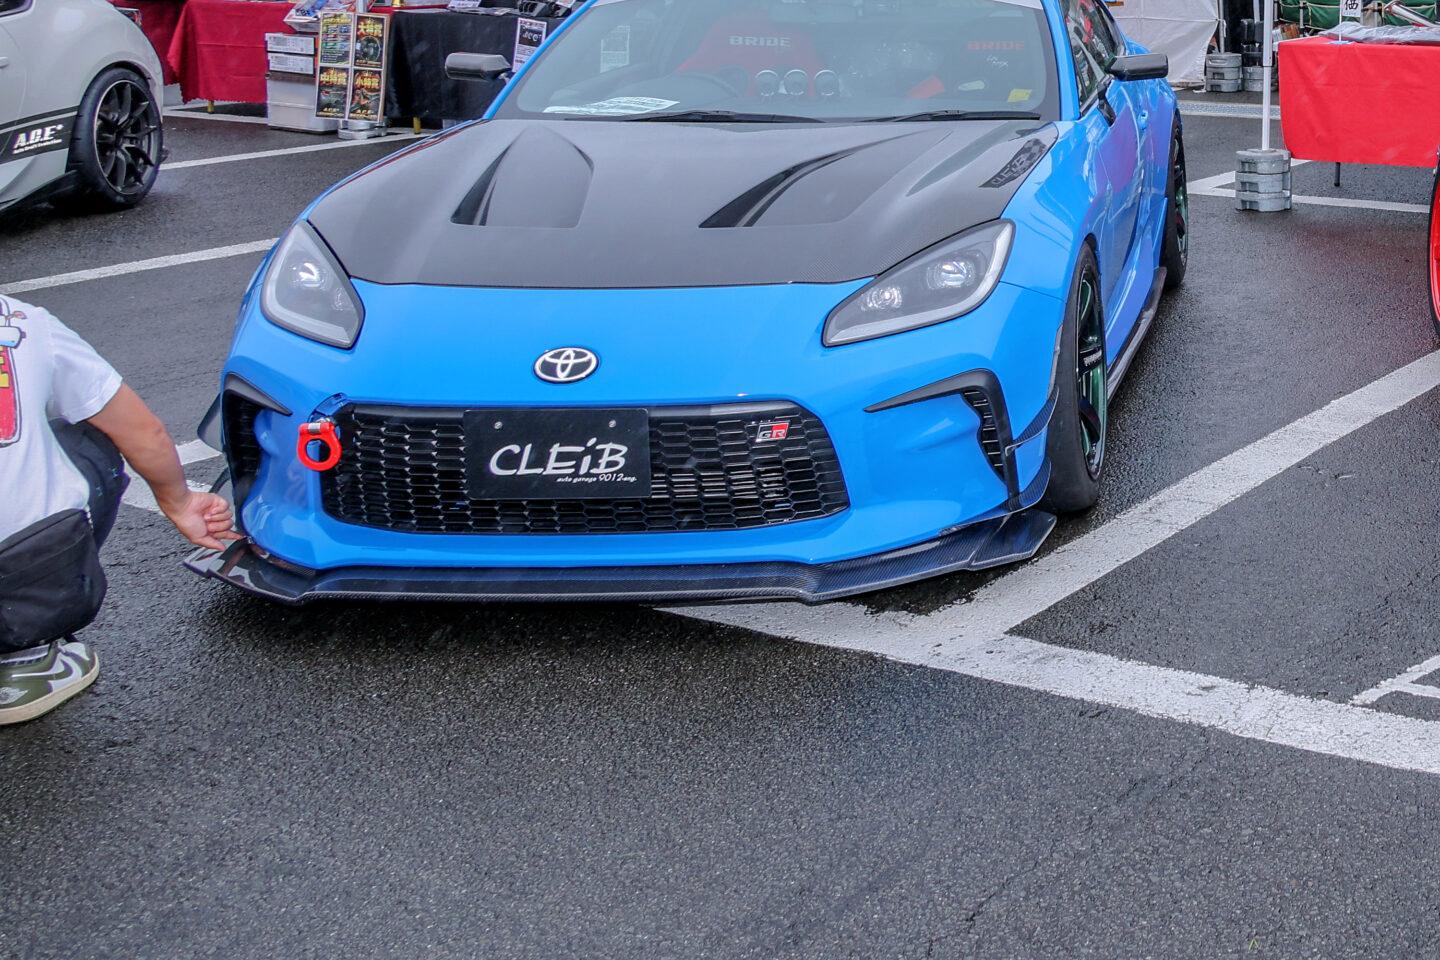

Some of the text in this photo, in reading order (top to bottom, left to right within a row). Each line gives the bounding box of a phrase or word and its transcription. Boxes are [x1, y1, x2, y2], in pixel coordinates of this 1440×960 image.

[729, 35, 792, 48] BRIDE
[966, 40, 1025, 51] BRIDE
[758, 424, 788, 440] GR
